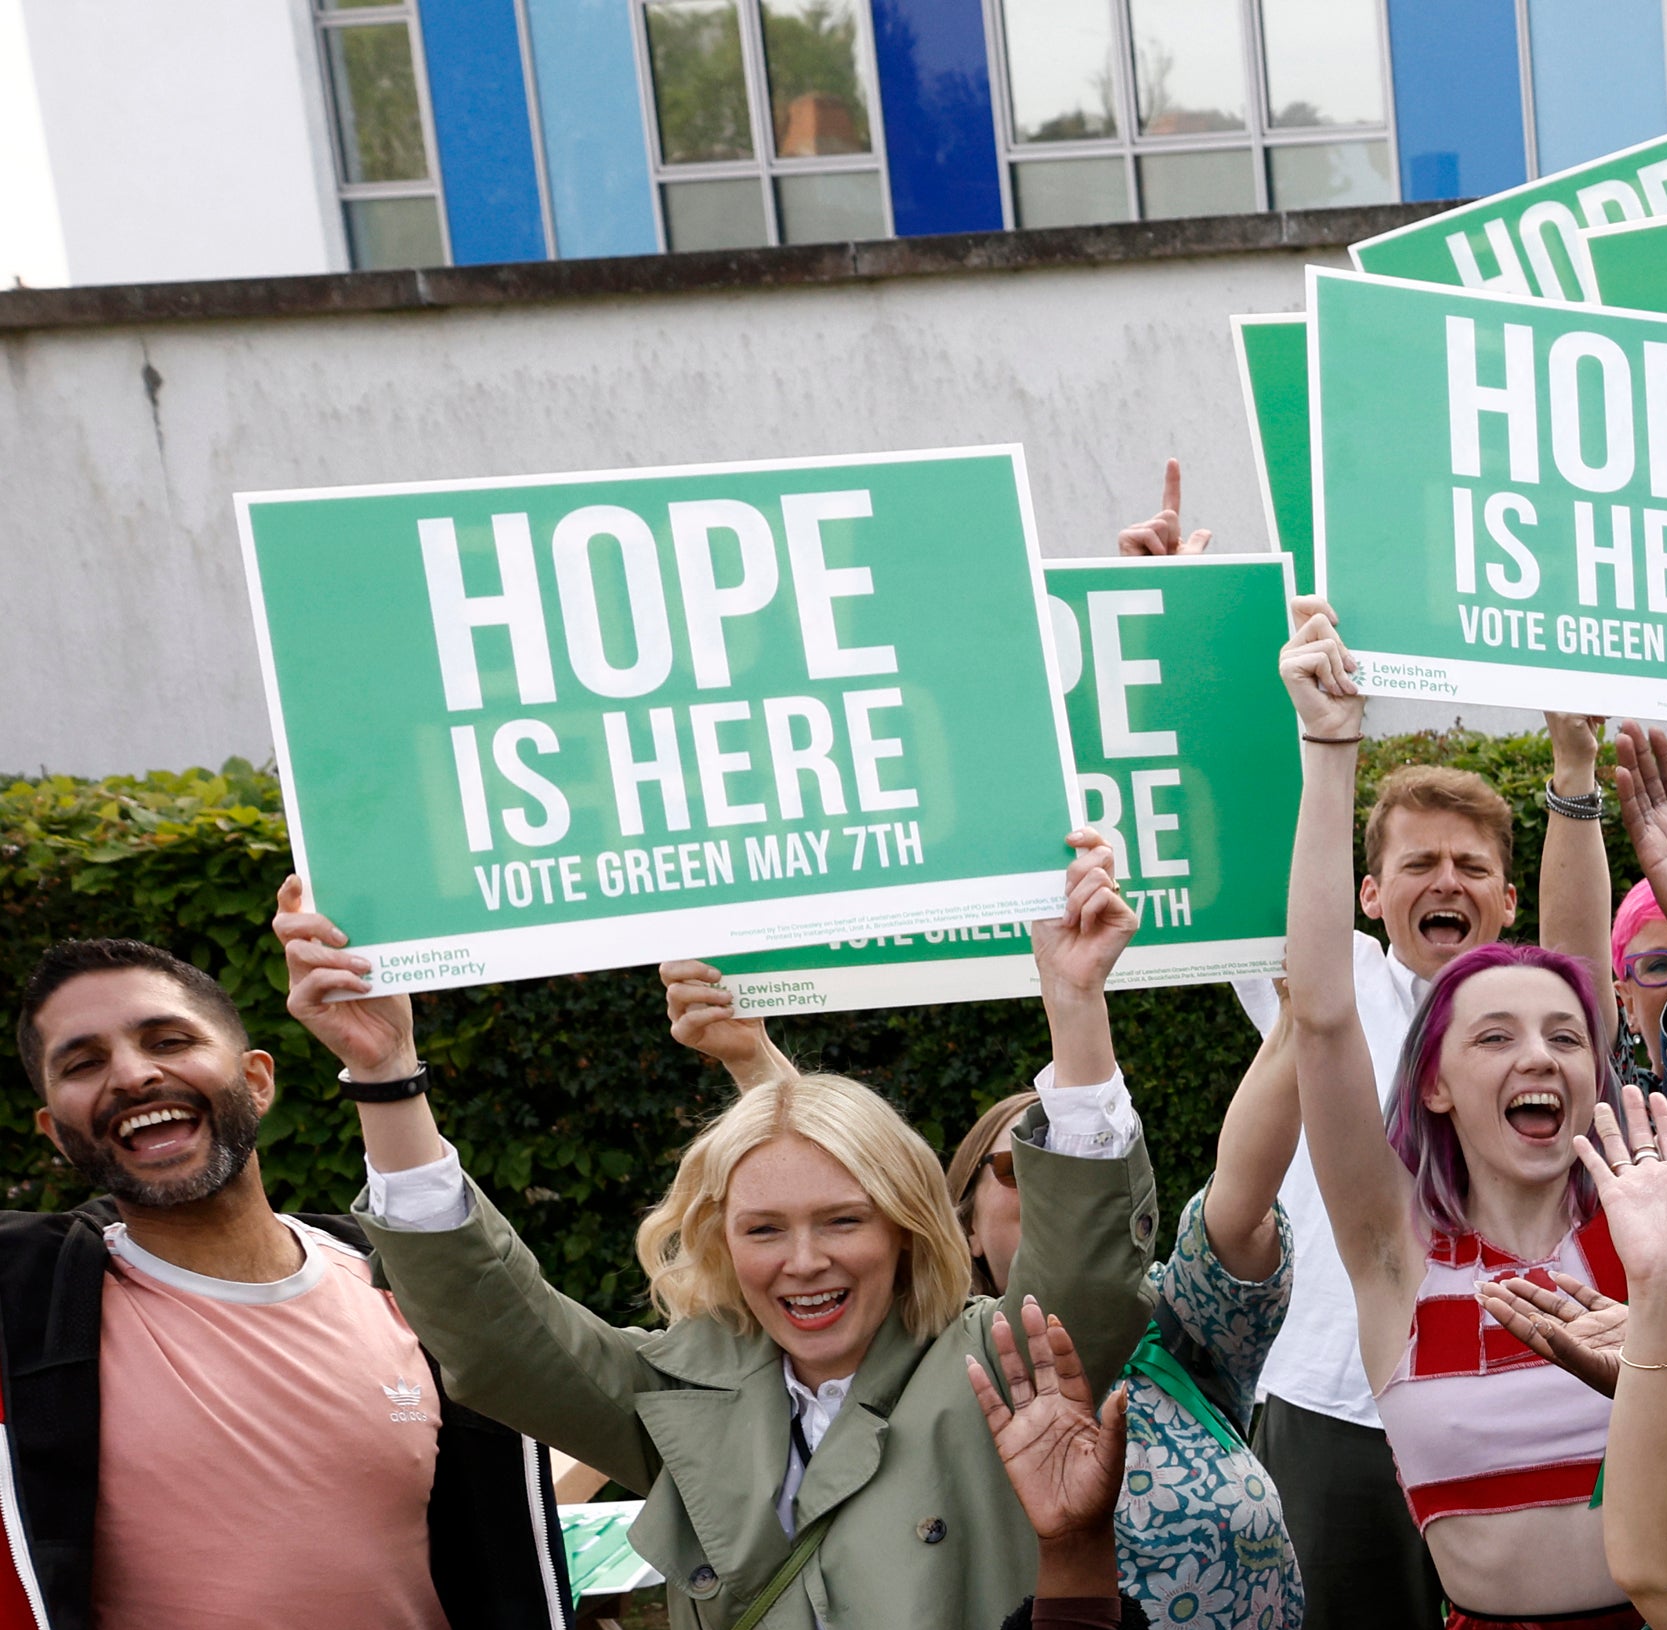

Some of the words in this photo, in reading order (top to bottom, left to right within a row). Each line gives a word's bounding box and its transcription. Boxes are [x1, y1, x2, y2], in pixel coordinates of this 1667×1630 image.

[1452, 486, 1542, 600] IS
[417, 488, 898, 713] HOPE
[1458, 604, 1546, 652] VOTE
[1557, 615, 1666, 663] GREEN
[1371, 674, 1416, 691] Green
[1419, 678, 1458, 697] Party
[1372, 661, 1447, 679] Lewisham
[450, 717, 570, 852] IS
[601, 687, 921, 837] HERE
[1078, 768, 1190, 880] RE
[474, 856, 588, 911] VOTE
[596, 839, 735, 898] GREEN
[745, 829, 833, 881] MAY
[841, 819, 924, 871] 7TH
[1125, 887, 1192, 929] 7TH
[379, 946, 470, 970] Lewisham
[380, 962, 436, 983] Green
[439, 958, 486, 984] Party
[738, 979, 815, 996] Lewisham
[739, 993, 784, 1010] Green
[788, 990, 828, 1009] Party
